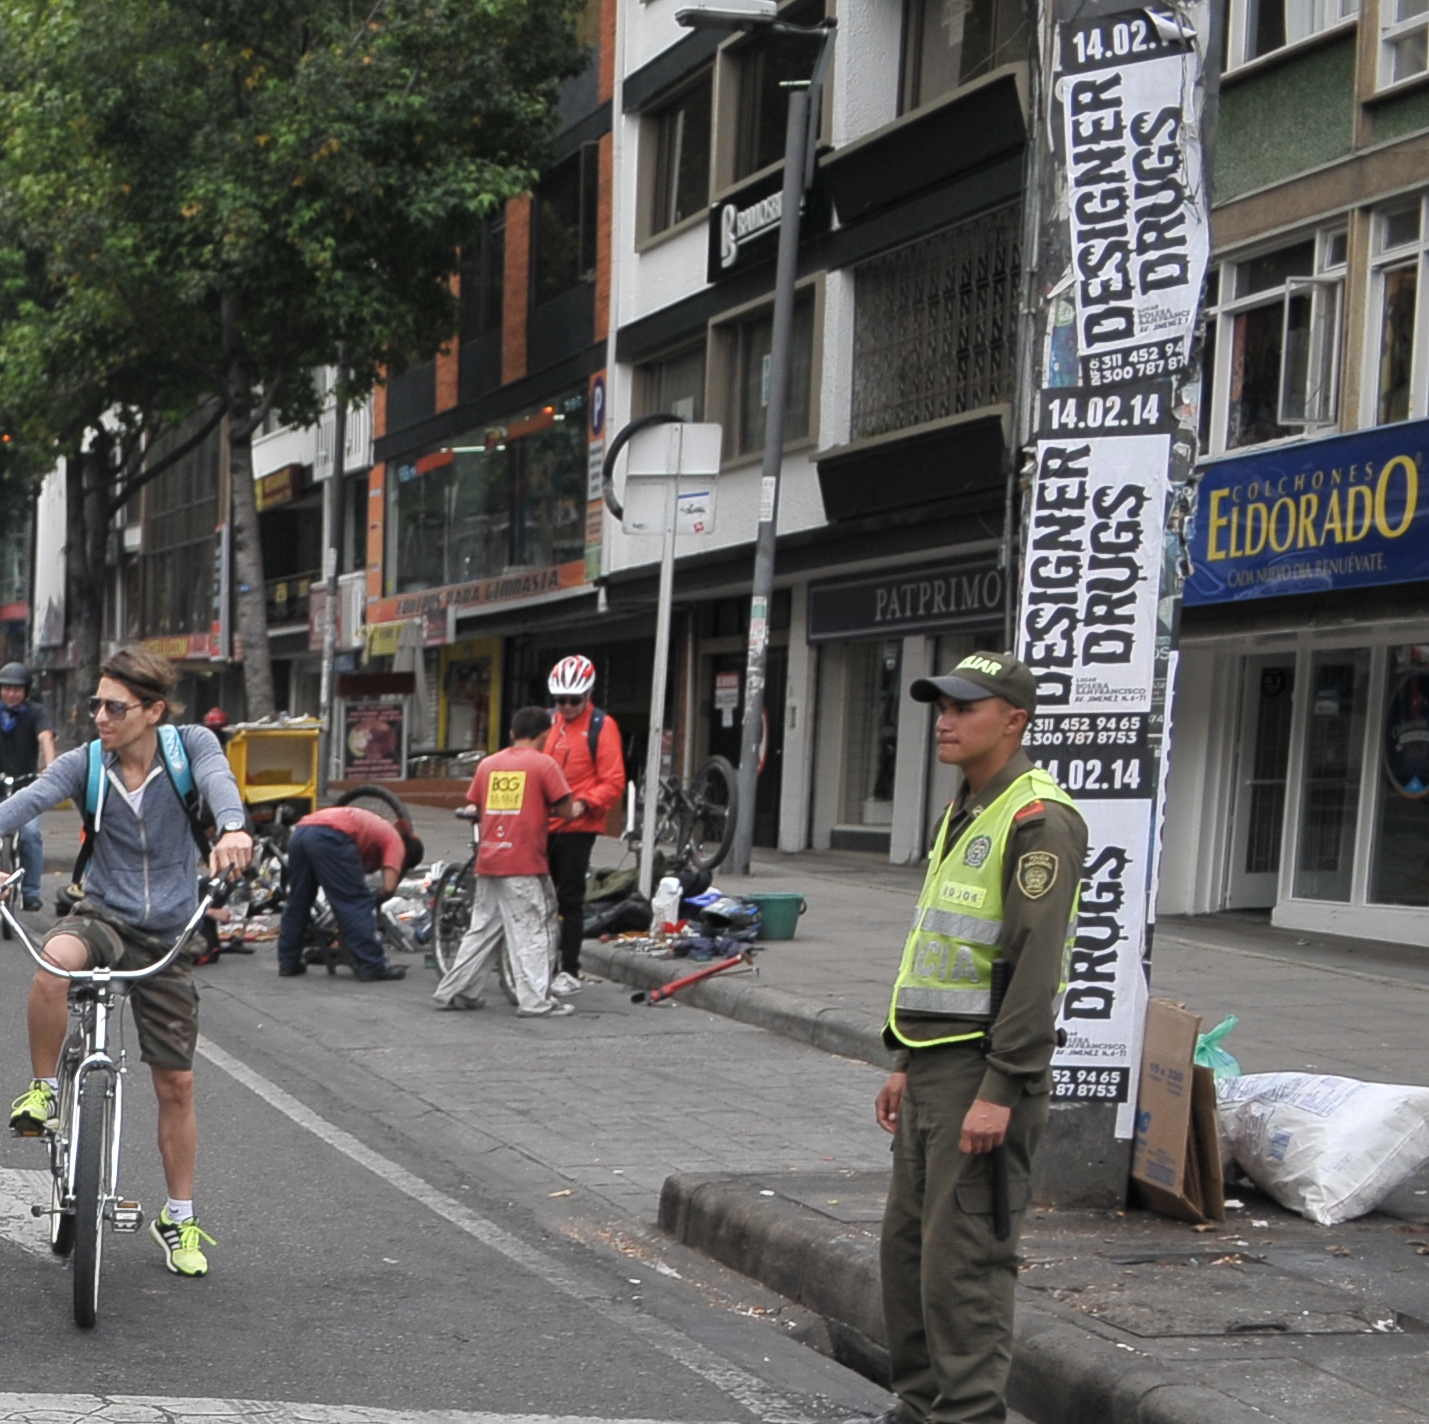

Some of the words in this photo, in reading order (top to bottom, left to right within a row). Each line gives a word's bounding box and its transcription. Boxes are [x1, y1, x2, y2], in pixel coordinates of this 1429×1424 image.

[1071, 72, 1135, 349] DESIGNER
[1130, 106, 1190, 296] DRUGS
[1102, 354, 1121, 369] 311
[1129, 346, 1159, 363] 452
[1103, 367, 1133, 383] 300
[1136, 361, 1164, 377] 787
[1048, 393, 1159, 429] 14.02.14
[1233, 462, 1373, 501] COLCHONES
[1023, 443, 1091, 706] DESIGNER
[1082, 483, 1153, 667] DRUGS
[875, 570, 1002, 621] PATPRIMO
[1032, 732, 1063, 745] 300
[1065, 731, 1095, 744] 787
[1097, 731, 1137, 744] 8753
[1034, 718, 1055, 731] 311
[1060, 718, 1090, 730] 452
[1077, 1084, 1117, 1097] 8753
